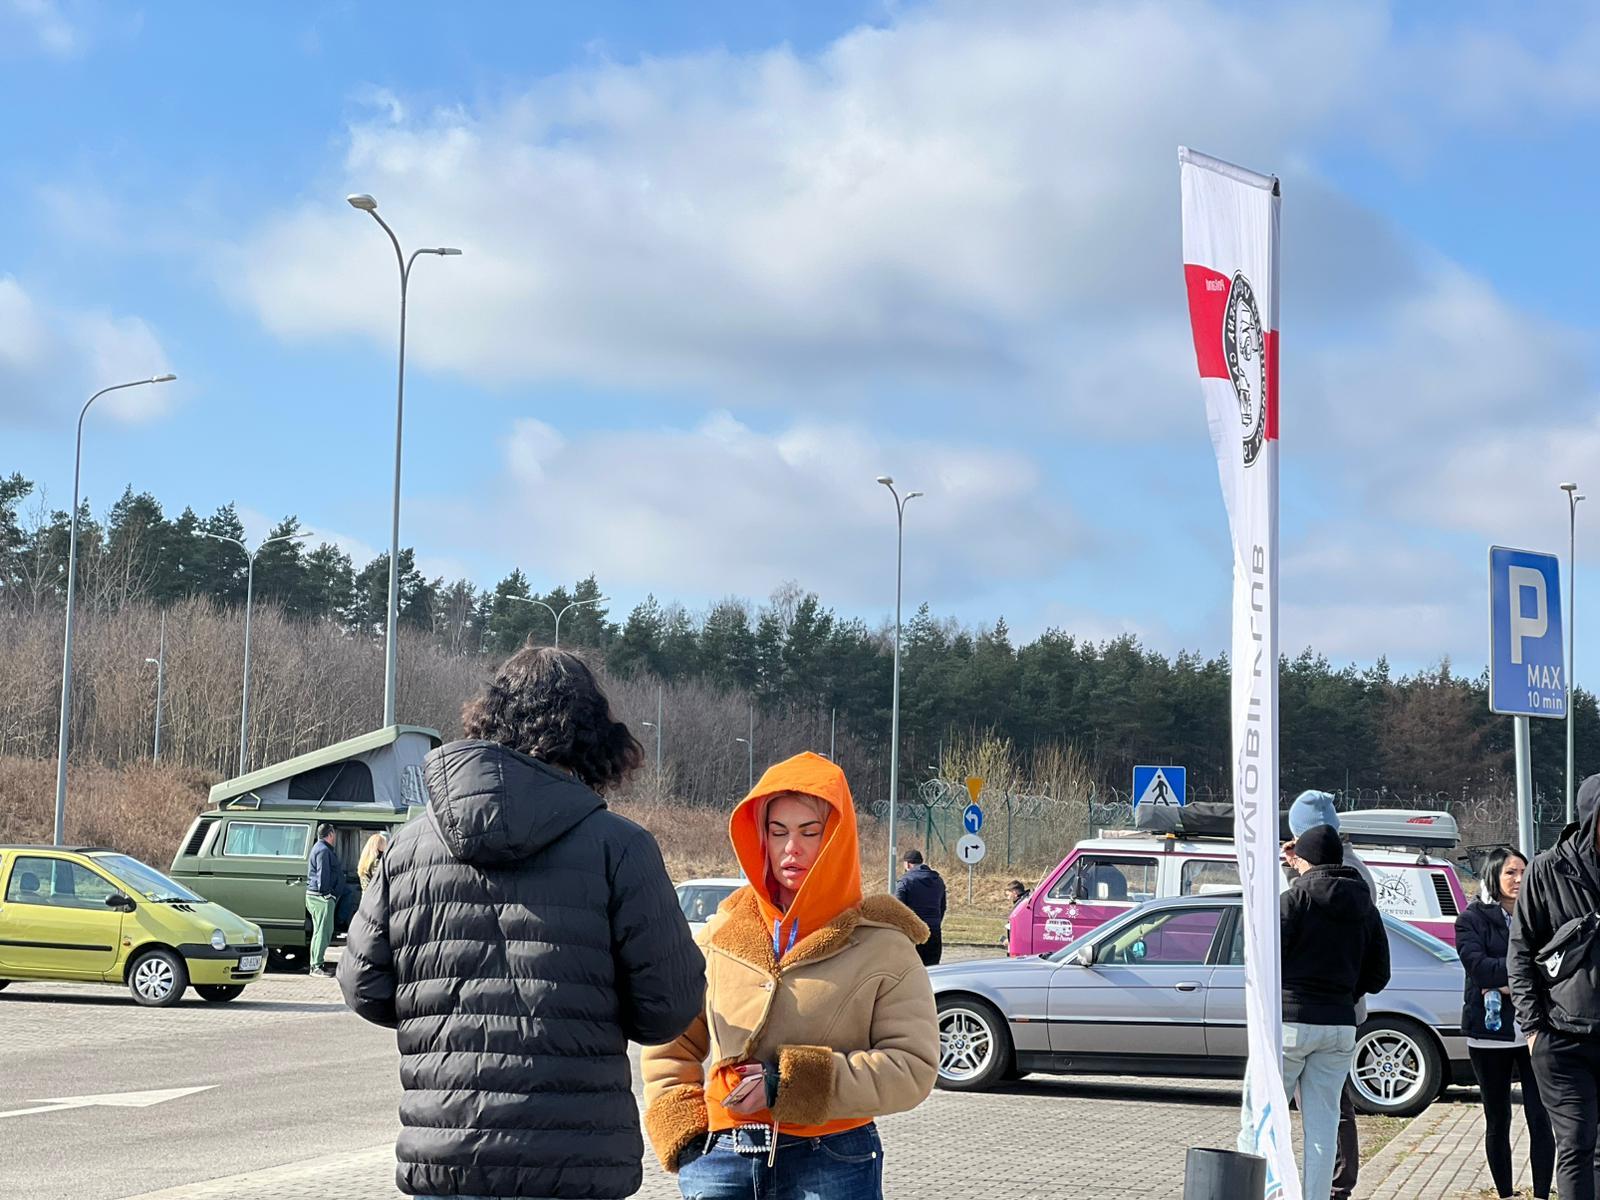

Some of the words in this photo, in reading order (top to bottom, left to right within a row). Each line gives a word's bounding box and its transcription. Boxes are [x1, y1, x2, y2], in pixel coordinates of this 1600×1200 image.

[1508, 565, 1548, 665] P
[1527, 664, 1561, 690] MAX
[1527, 691, 1540, 708] 10
[1542, 693, 1563, 710] min
